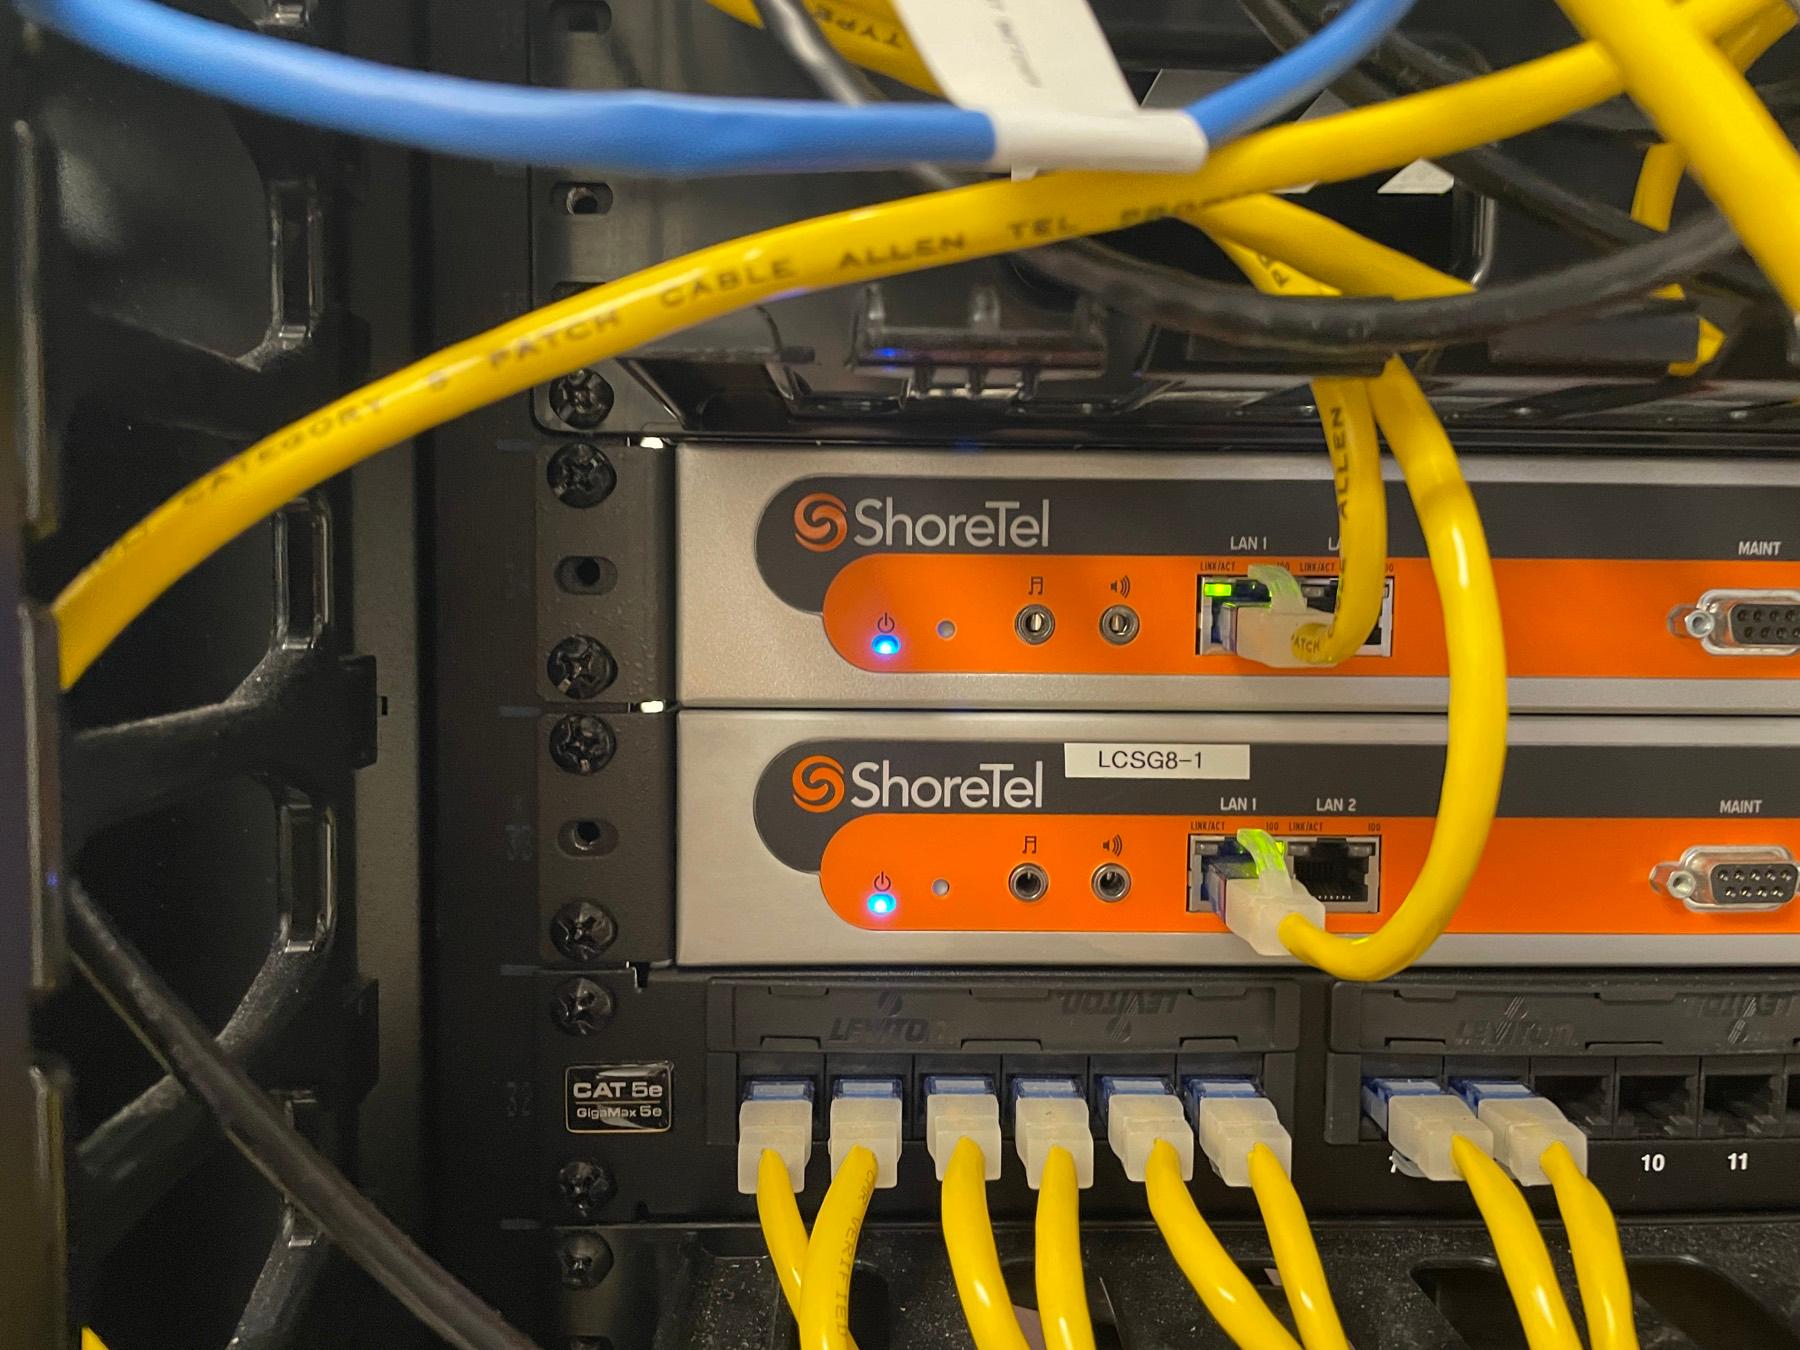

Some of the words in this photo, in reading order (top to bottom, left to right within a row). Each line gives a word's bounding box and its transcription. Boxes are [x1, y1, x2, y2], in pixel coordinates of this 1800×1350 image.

[488, 307, 621, 370] PATCH
[658, 257, 797, 308] CABLE
[838, 232, 966, 269] ALLEN
[1010, 216, 1080, 241] TEL
[1329, 406, 1348, 521] ALLEN
[853, 496, 1050, 548] ShoreTel
[1230, 536, 1258, 550] LAN
[1262, 536, 1267, 550] 1
[1738, 541, 1782, 556] MAINT
[1200, 560, 1235, 571] LINK/ACT
[1098, 750, 1202, 770] LCSG8-1
[850, 758, 1043, 809] ShoreTel
[1220, 797, 1247, 811] LAN
[1252, 797, 1257, 811] 1
[1316, 798, 1343, 812] LAN
[1347, 798, 1357, 812] 2
[1719, 800, 1763, 814] MAINT
[1266, 821, 1279, 831] 100
[1368, 822, 1381, 832] 100
[573, 1081, 627, 1098] CAT
[631, 1081, 663, 1098] 5e
[576, 1106, 637, 1119] GigaMax
[639, 1105, 662, 1118] 5e
[1641, 1153, 1665, 1172] 10
[1727, 1152, 1749, 1171] 11
[835, 1216, 862, 1337] VERIFIED
